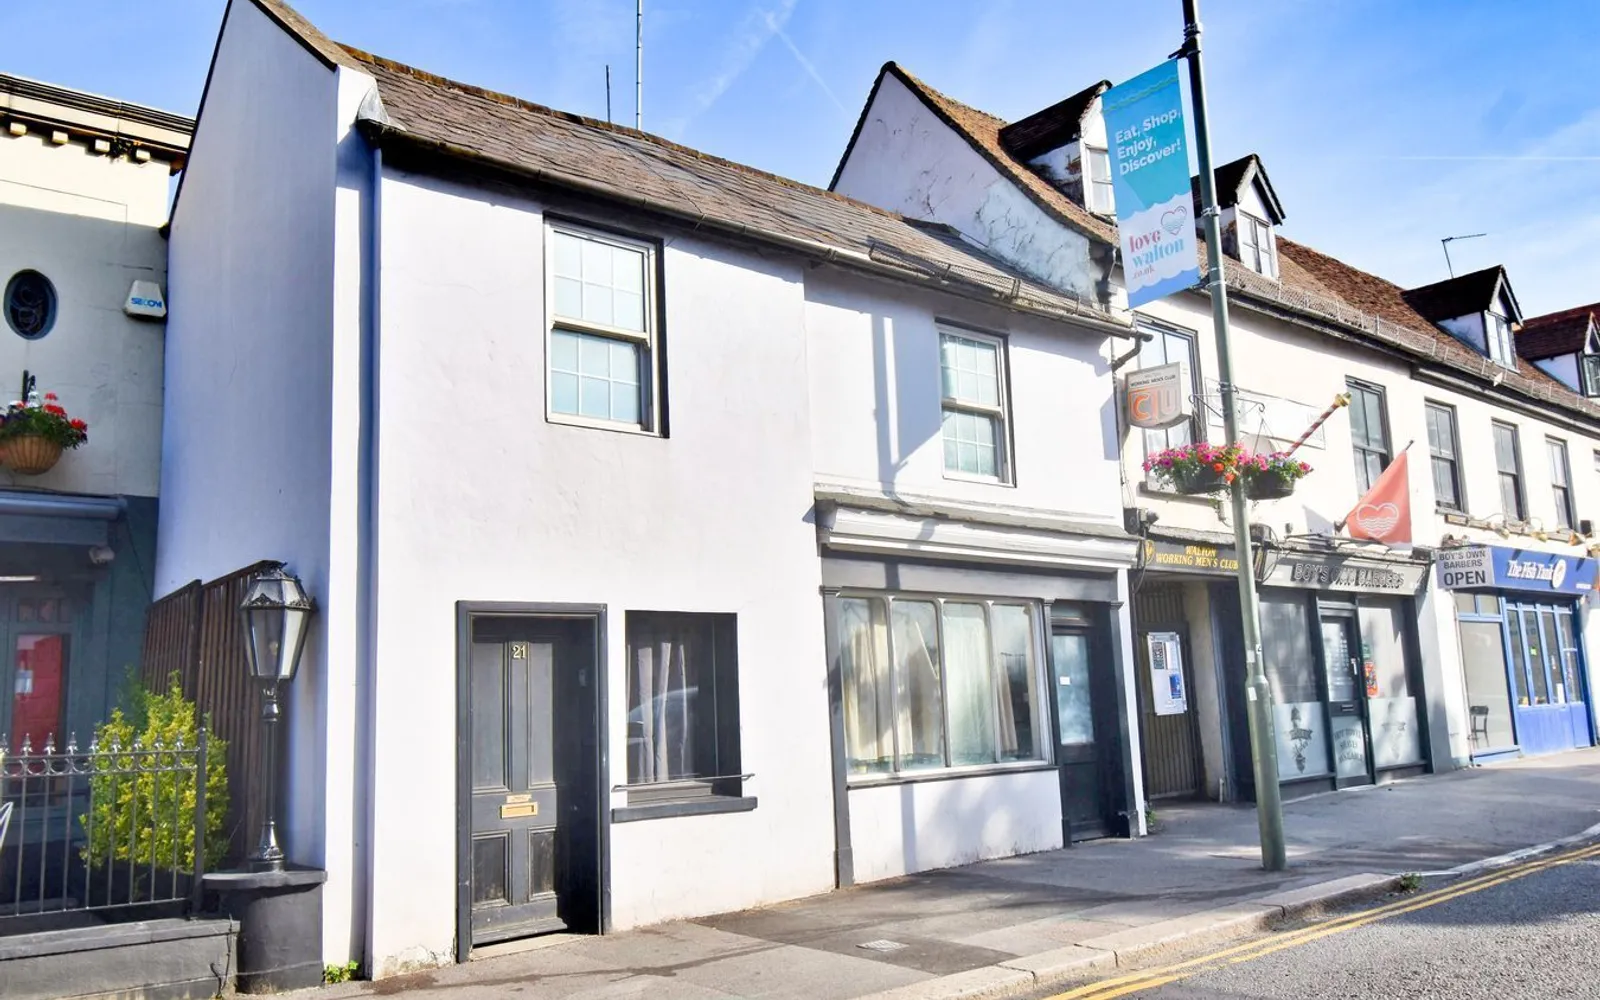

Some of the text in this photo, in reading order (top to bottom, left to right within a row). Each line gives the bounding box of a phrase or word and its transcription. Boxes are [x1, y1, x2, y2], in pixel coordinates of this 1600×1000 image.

[1115, 109, 1181, 145] Eat, Shop,
[1117, 135, 1157, 160] Enjoy,
[1119, 138, 1182, 176] Discover!
[1129, 231, 1161, 253] love
[1132, 238, 1184, 268] walton
[1186, 545, 1217, 557] WALTON
[1438, 551, 1486, 561] BOY'S OWN
[1155, 553, 1239, 570] WORKING MEN'S CLUB
[1443, 559, 1482, 569] BARBERS
[1507, 560, 1522, 577] The
[1521, 562, 1536, 579] Fish
[1294, 563, 1329, 582] BOY'S
[1444, 570, 1486, 586] OPEN
[511, 645, 527, 660] 21
